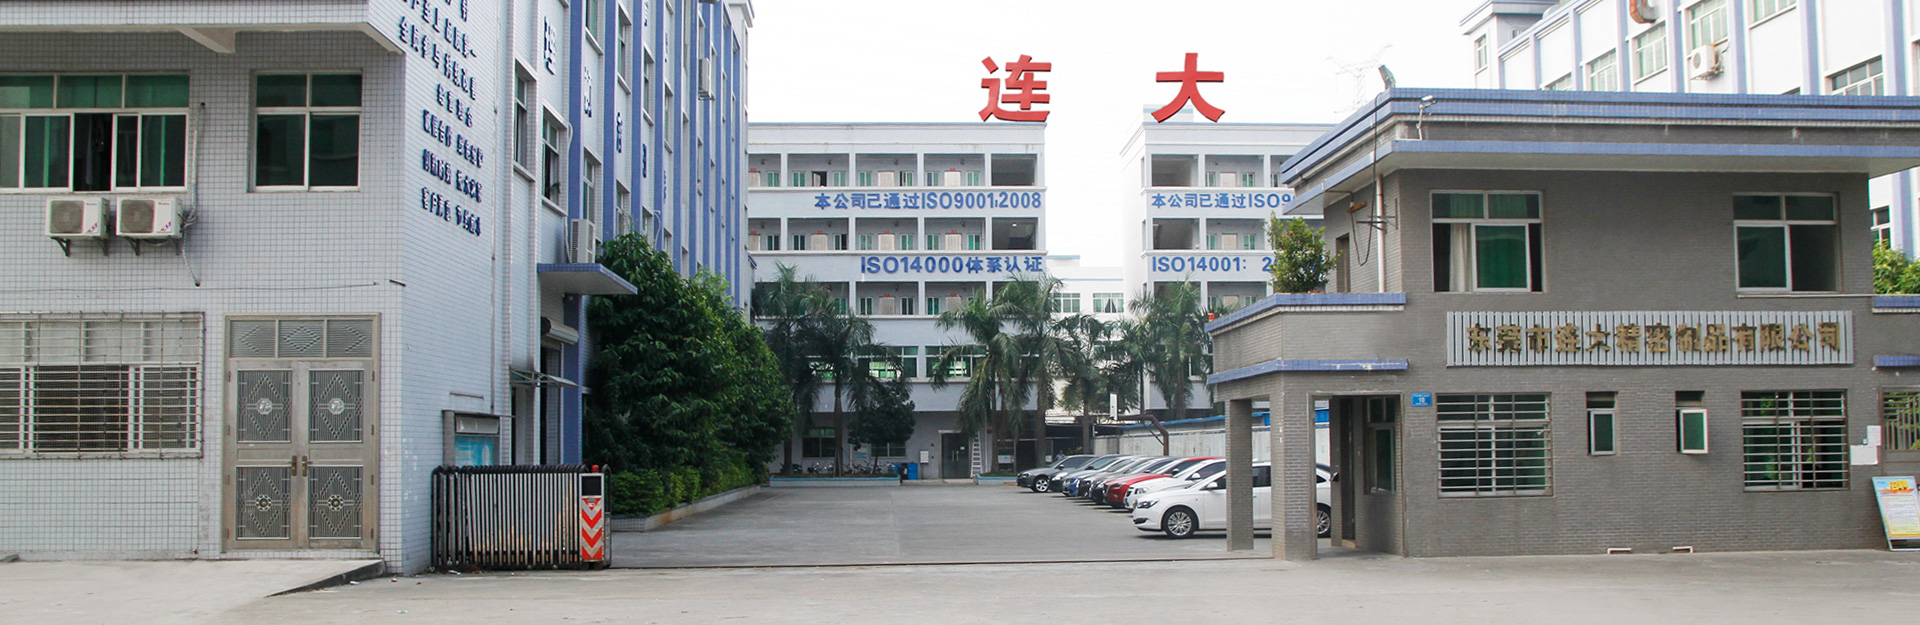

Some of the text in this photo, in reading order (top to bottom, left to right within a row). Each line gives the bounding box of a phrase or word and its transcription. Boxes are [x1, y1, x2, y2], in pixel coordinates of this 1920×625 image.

[978, 52, 1225, 123] 连 大
[860, 256, 1043, 274] ISO14000体系认证
